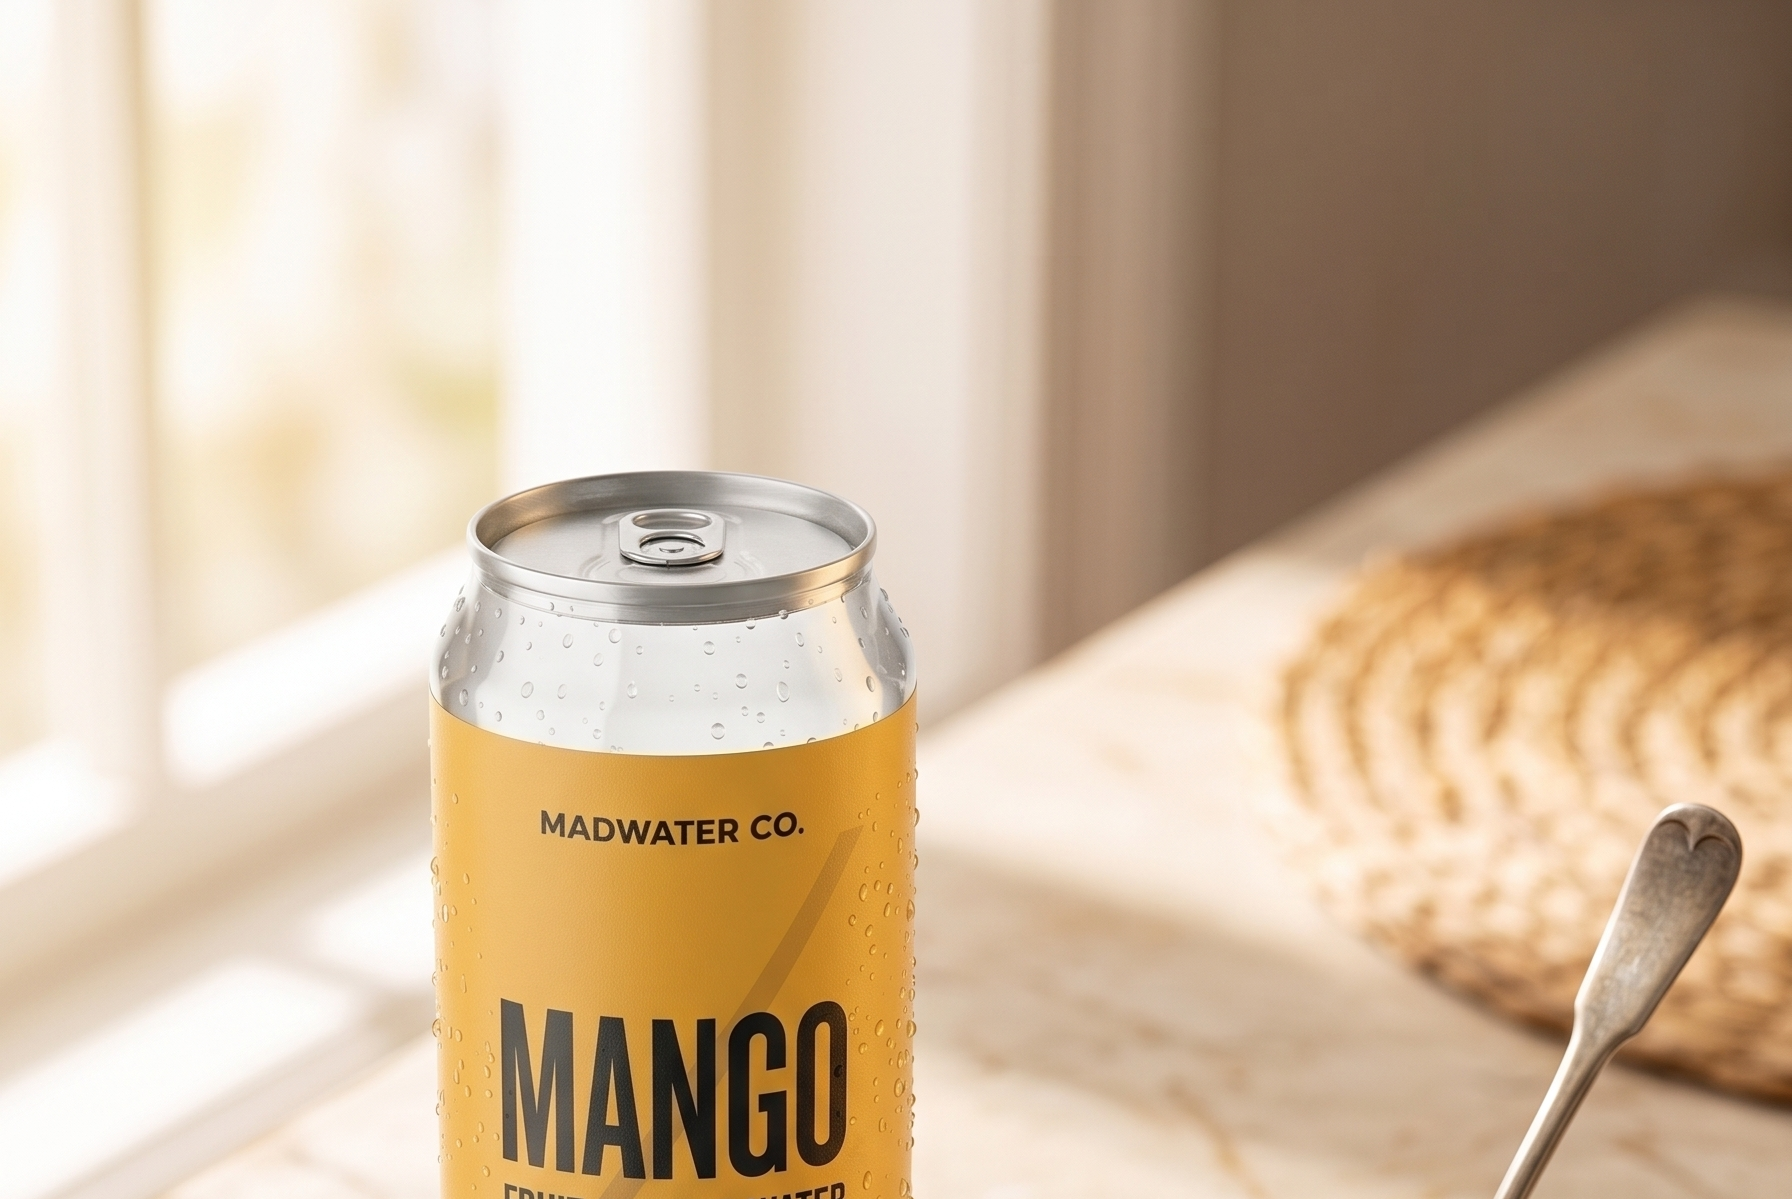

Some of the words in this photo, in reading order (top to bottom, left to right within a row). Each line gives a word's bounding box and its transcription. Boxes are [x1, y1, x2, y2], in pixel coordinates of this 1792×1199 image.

[540, 809, 740, 846] MADWATER
[750, 811, 805, 841] CO.
[499, 997, 849, 1180] MANGO
